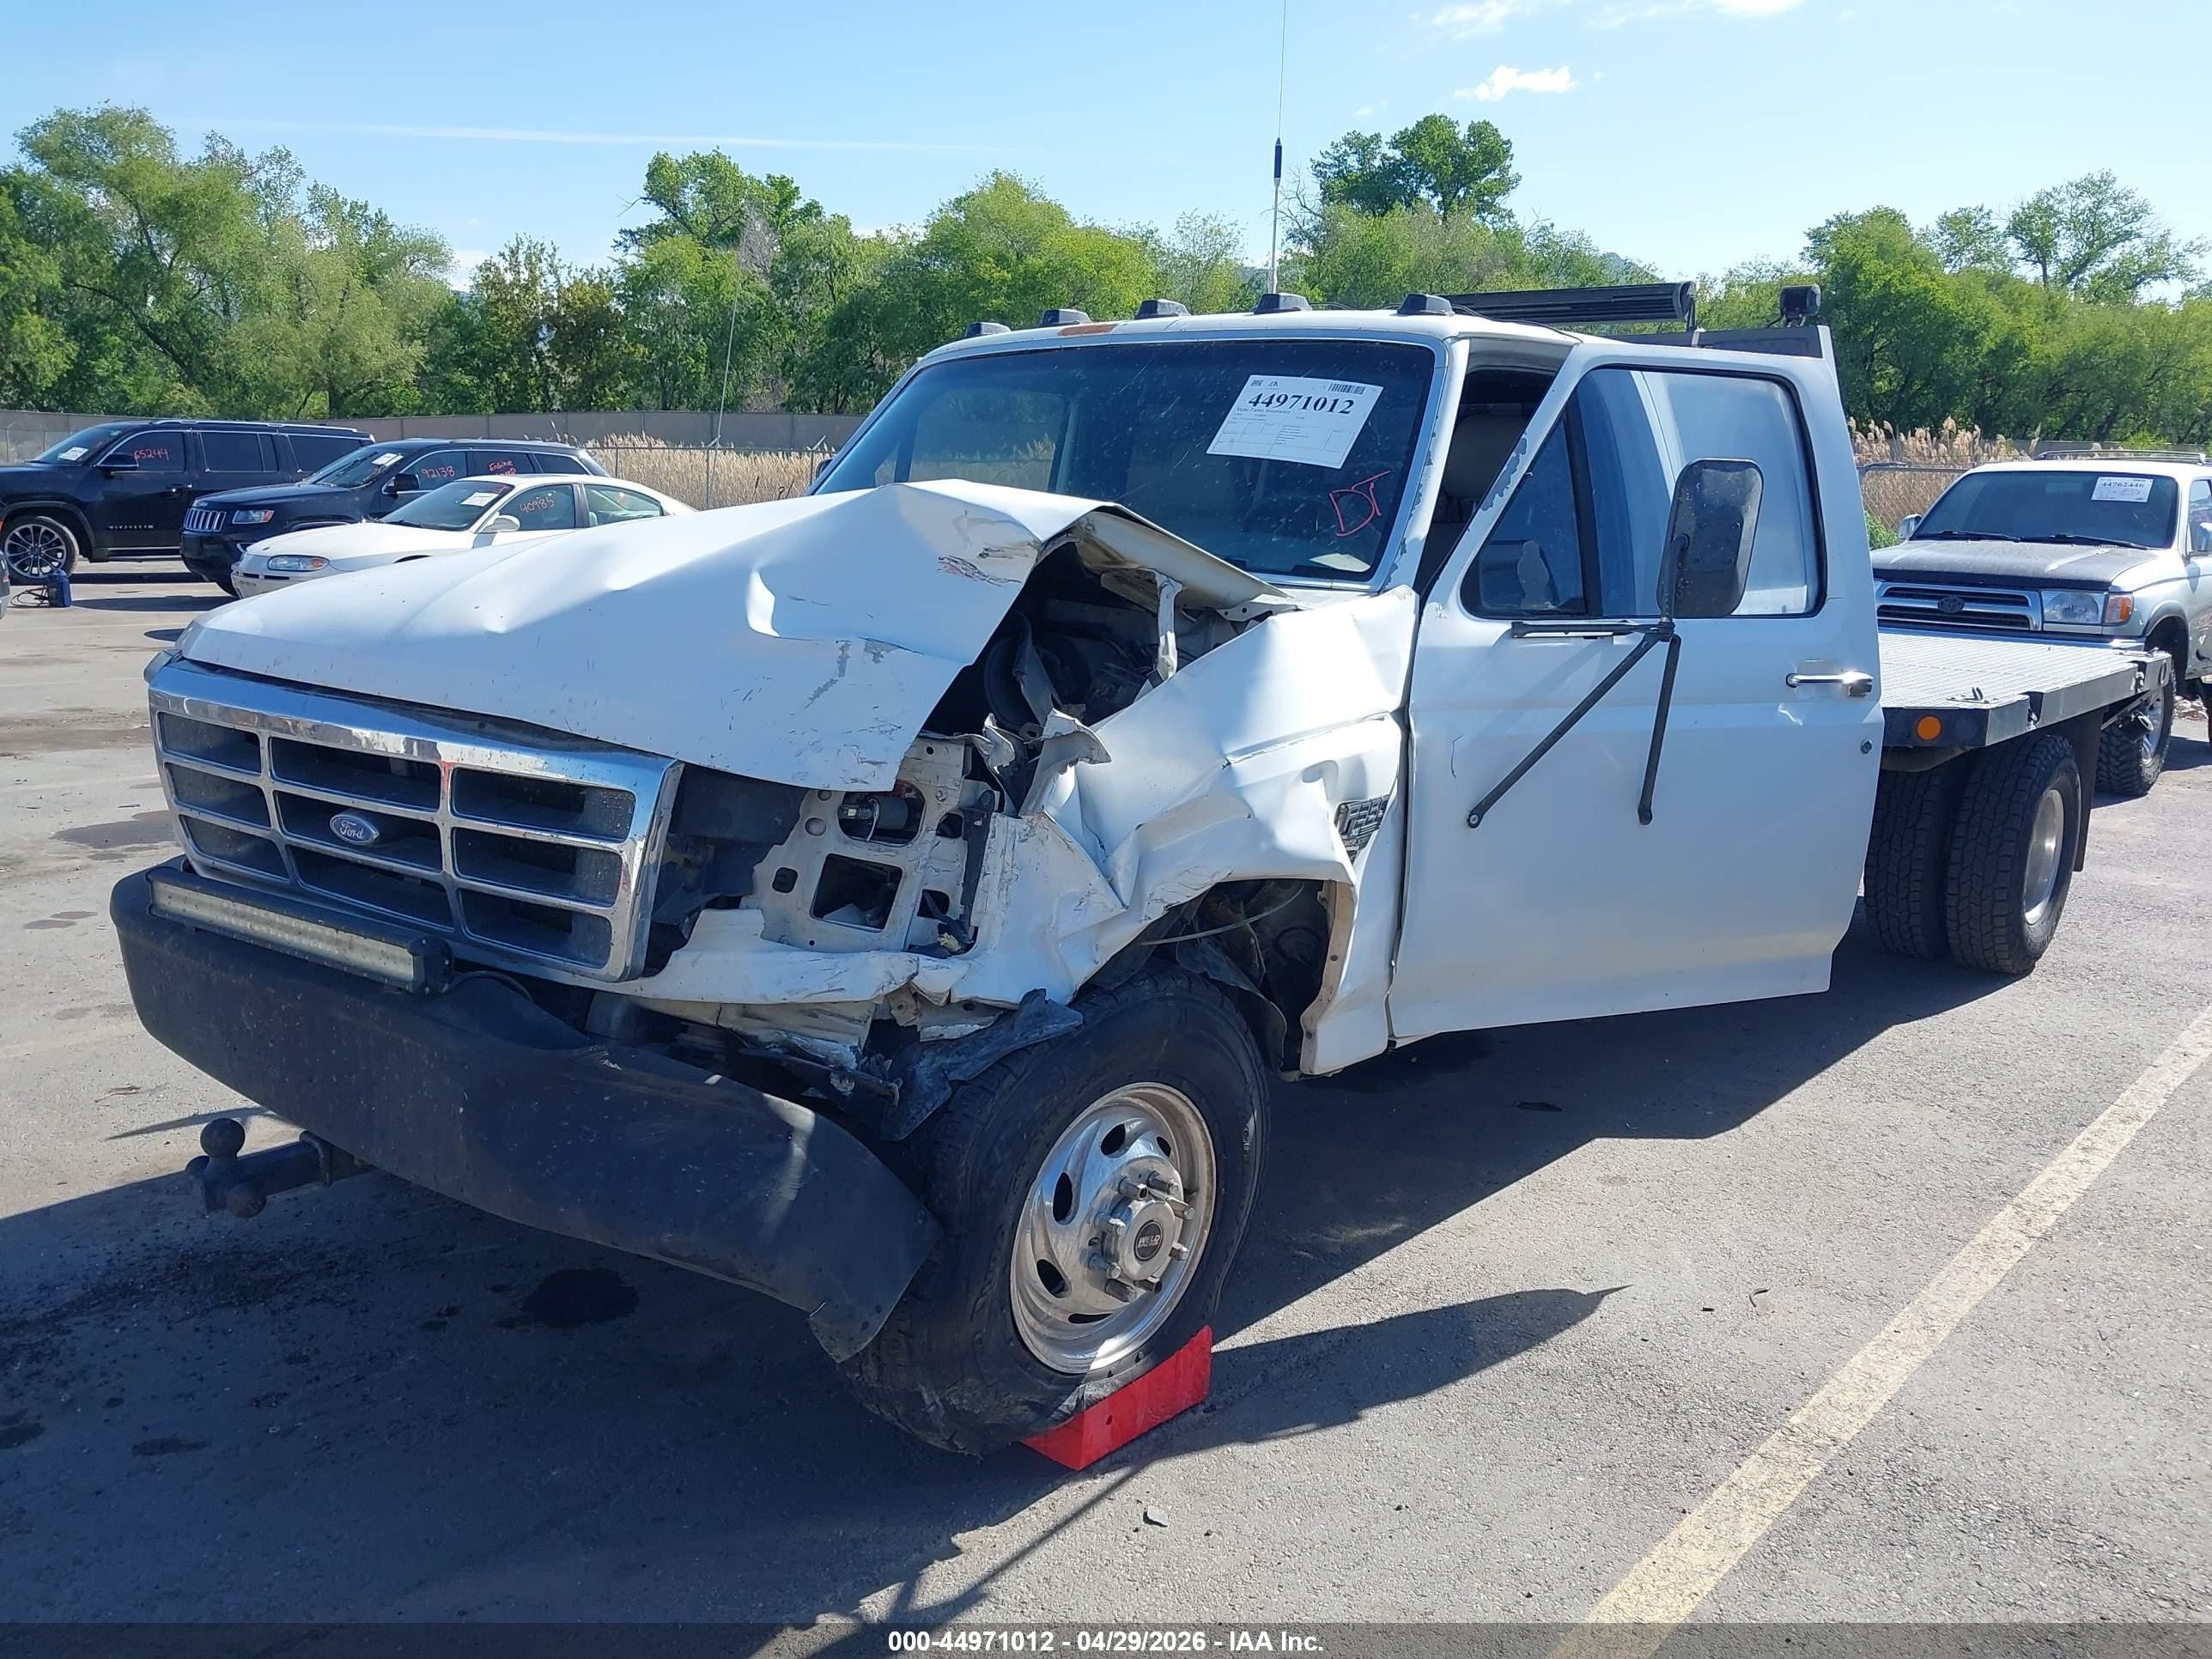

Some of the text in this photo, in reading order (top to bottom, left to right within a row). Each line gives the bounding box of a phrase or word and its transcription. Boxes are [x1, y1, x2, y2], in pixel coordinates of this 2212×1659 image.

[1249, 392, 1355, 415] 44971012
[421, 465, 455, 479] 92138
[520, 496, 556, 514] 40985
[339, 819, 365, 840] Ford
